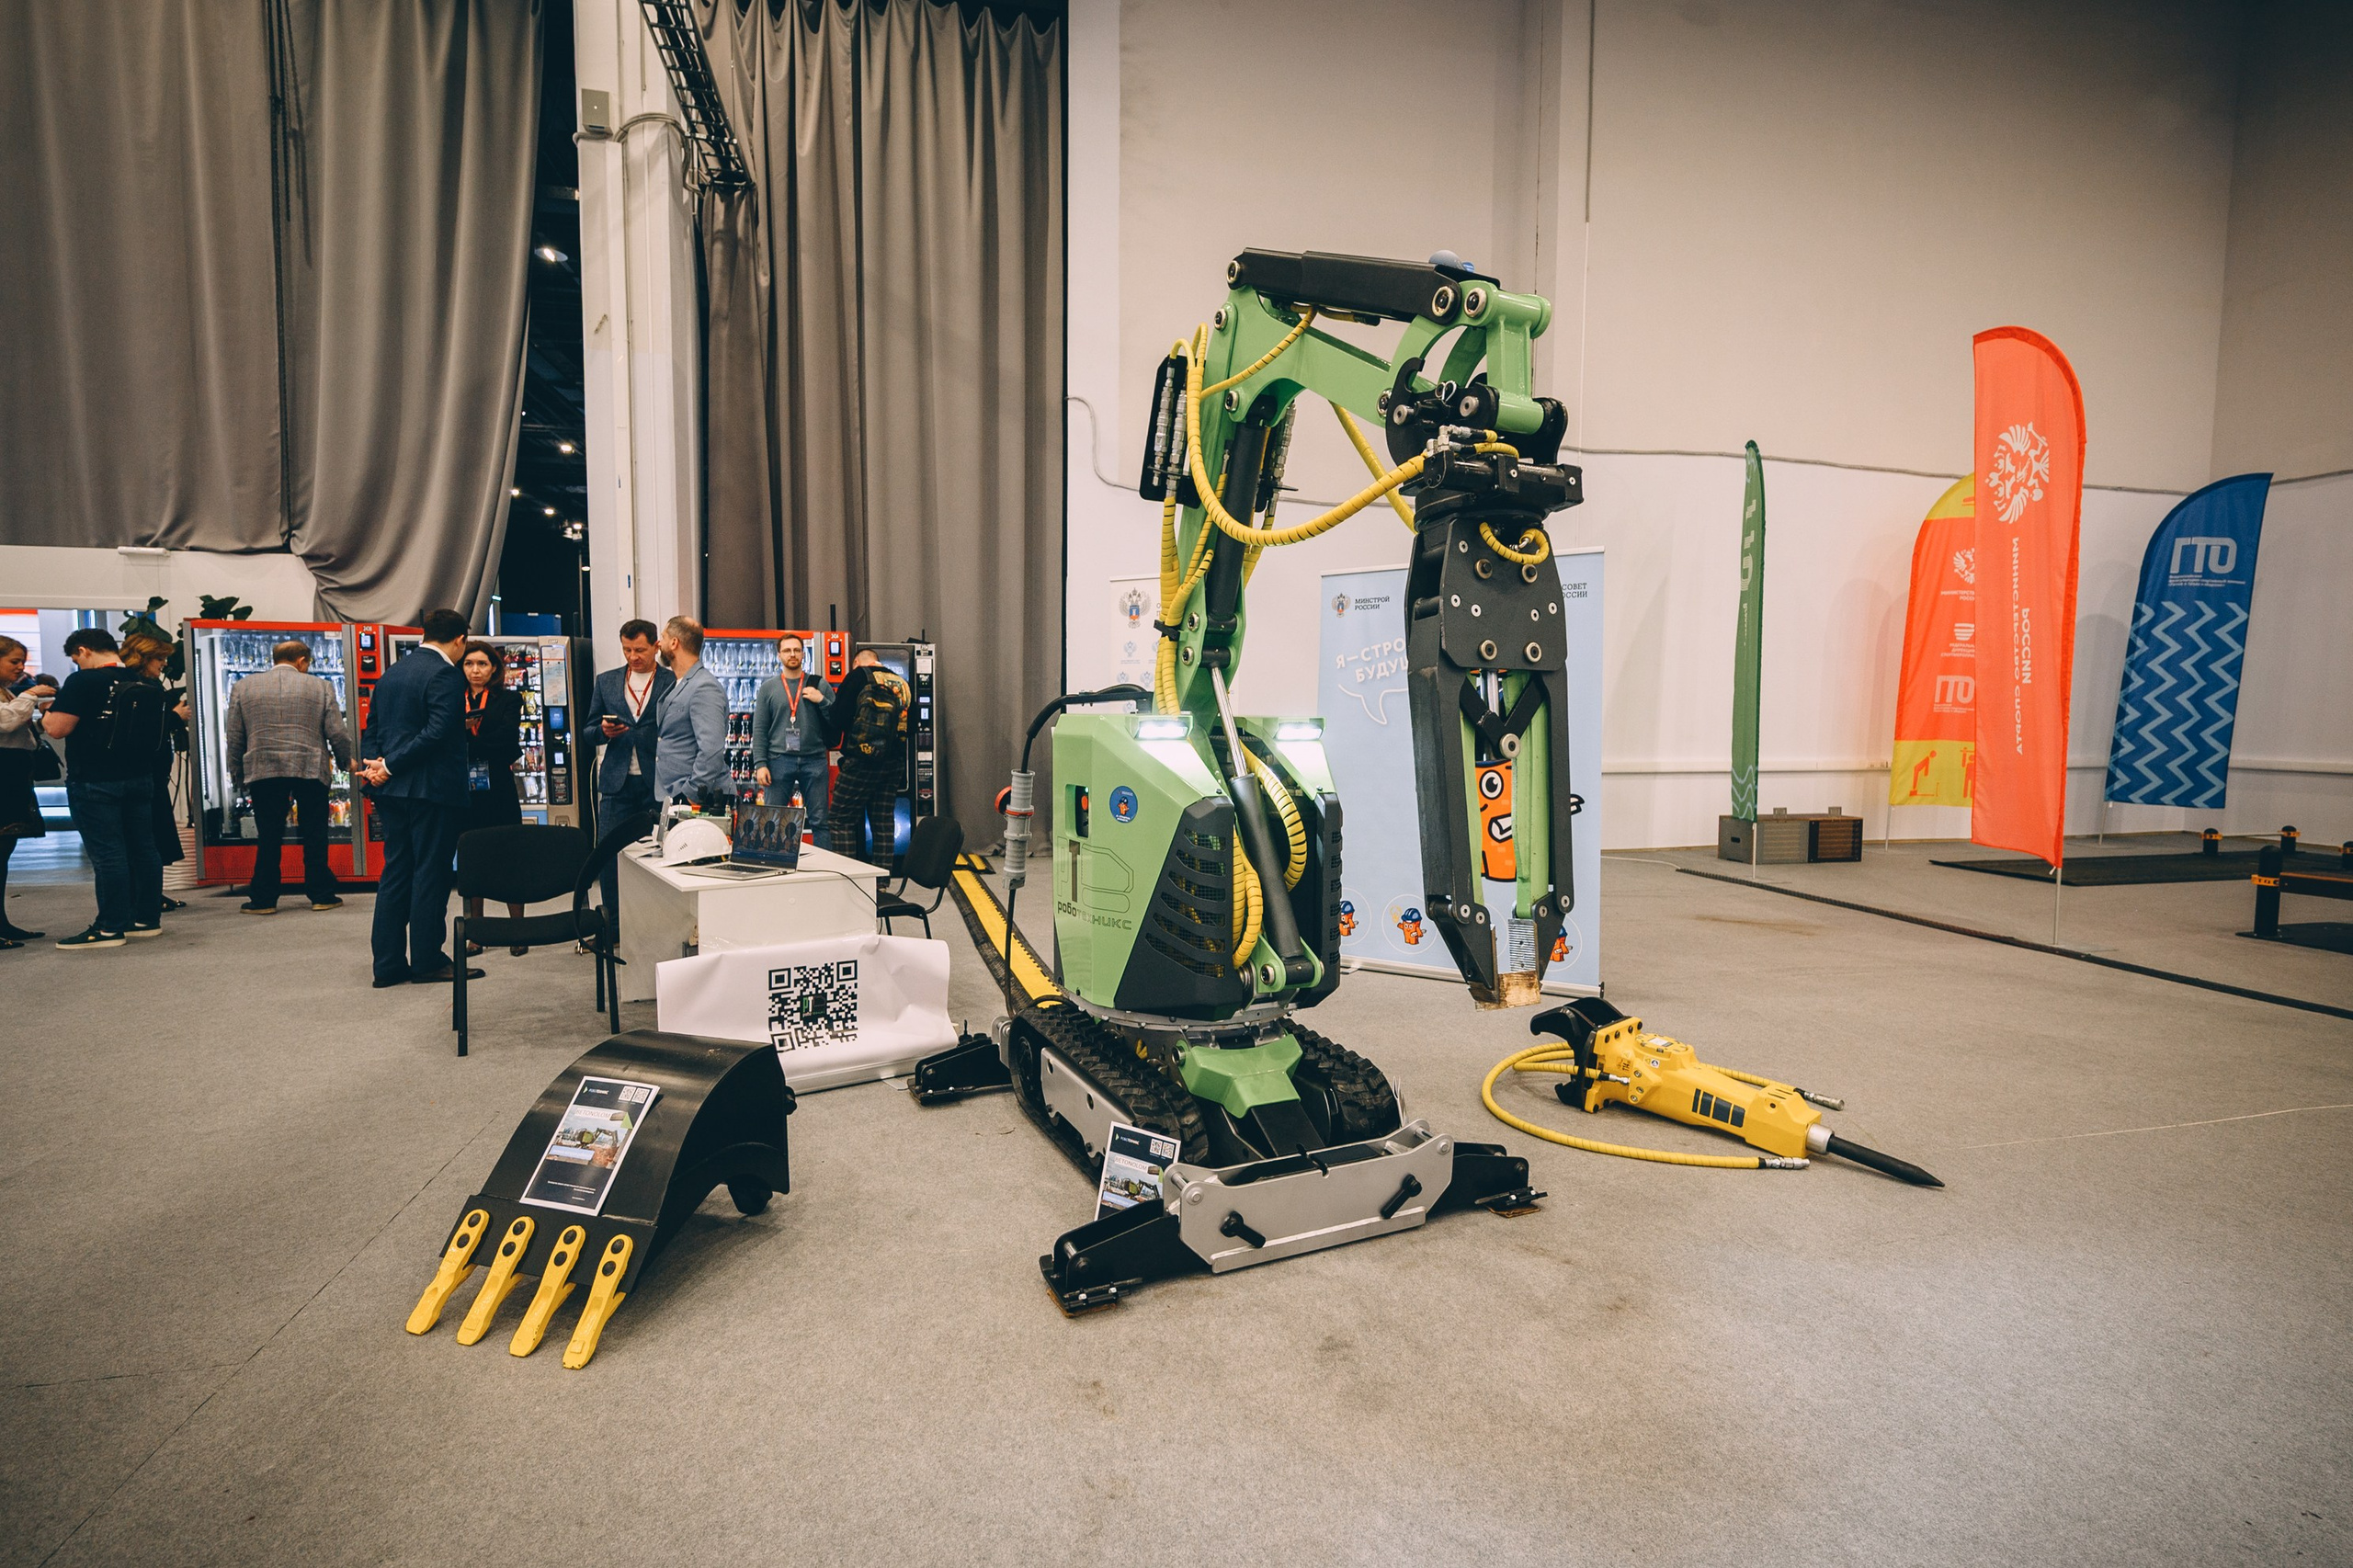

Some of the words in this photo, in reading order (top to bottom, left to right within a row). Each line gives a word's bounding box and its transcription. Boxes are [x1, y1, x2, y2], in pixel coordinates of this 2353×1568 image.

[2169, 537, 2237, 574] ГТО
[1355, 596, 1390, 604] МИНСТРОЙ
[1934, 675, 1975, 704] ГТО
